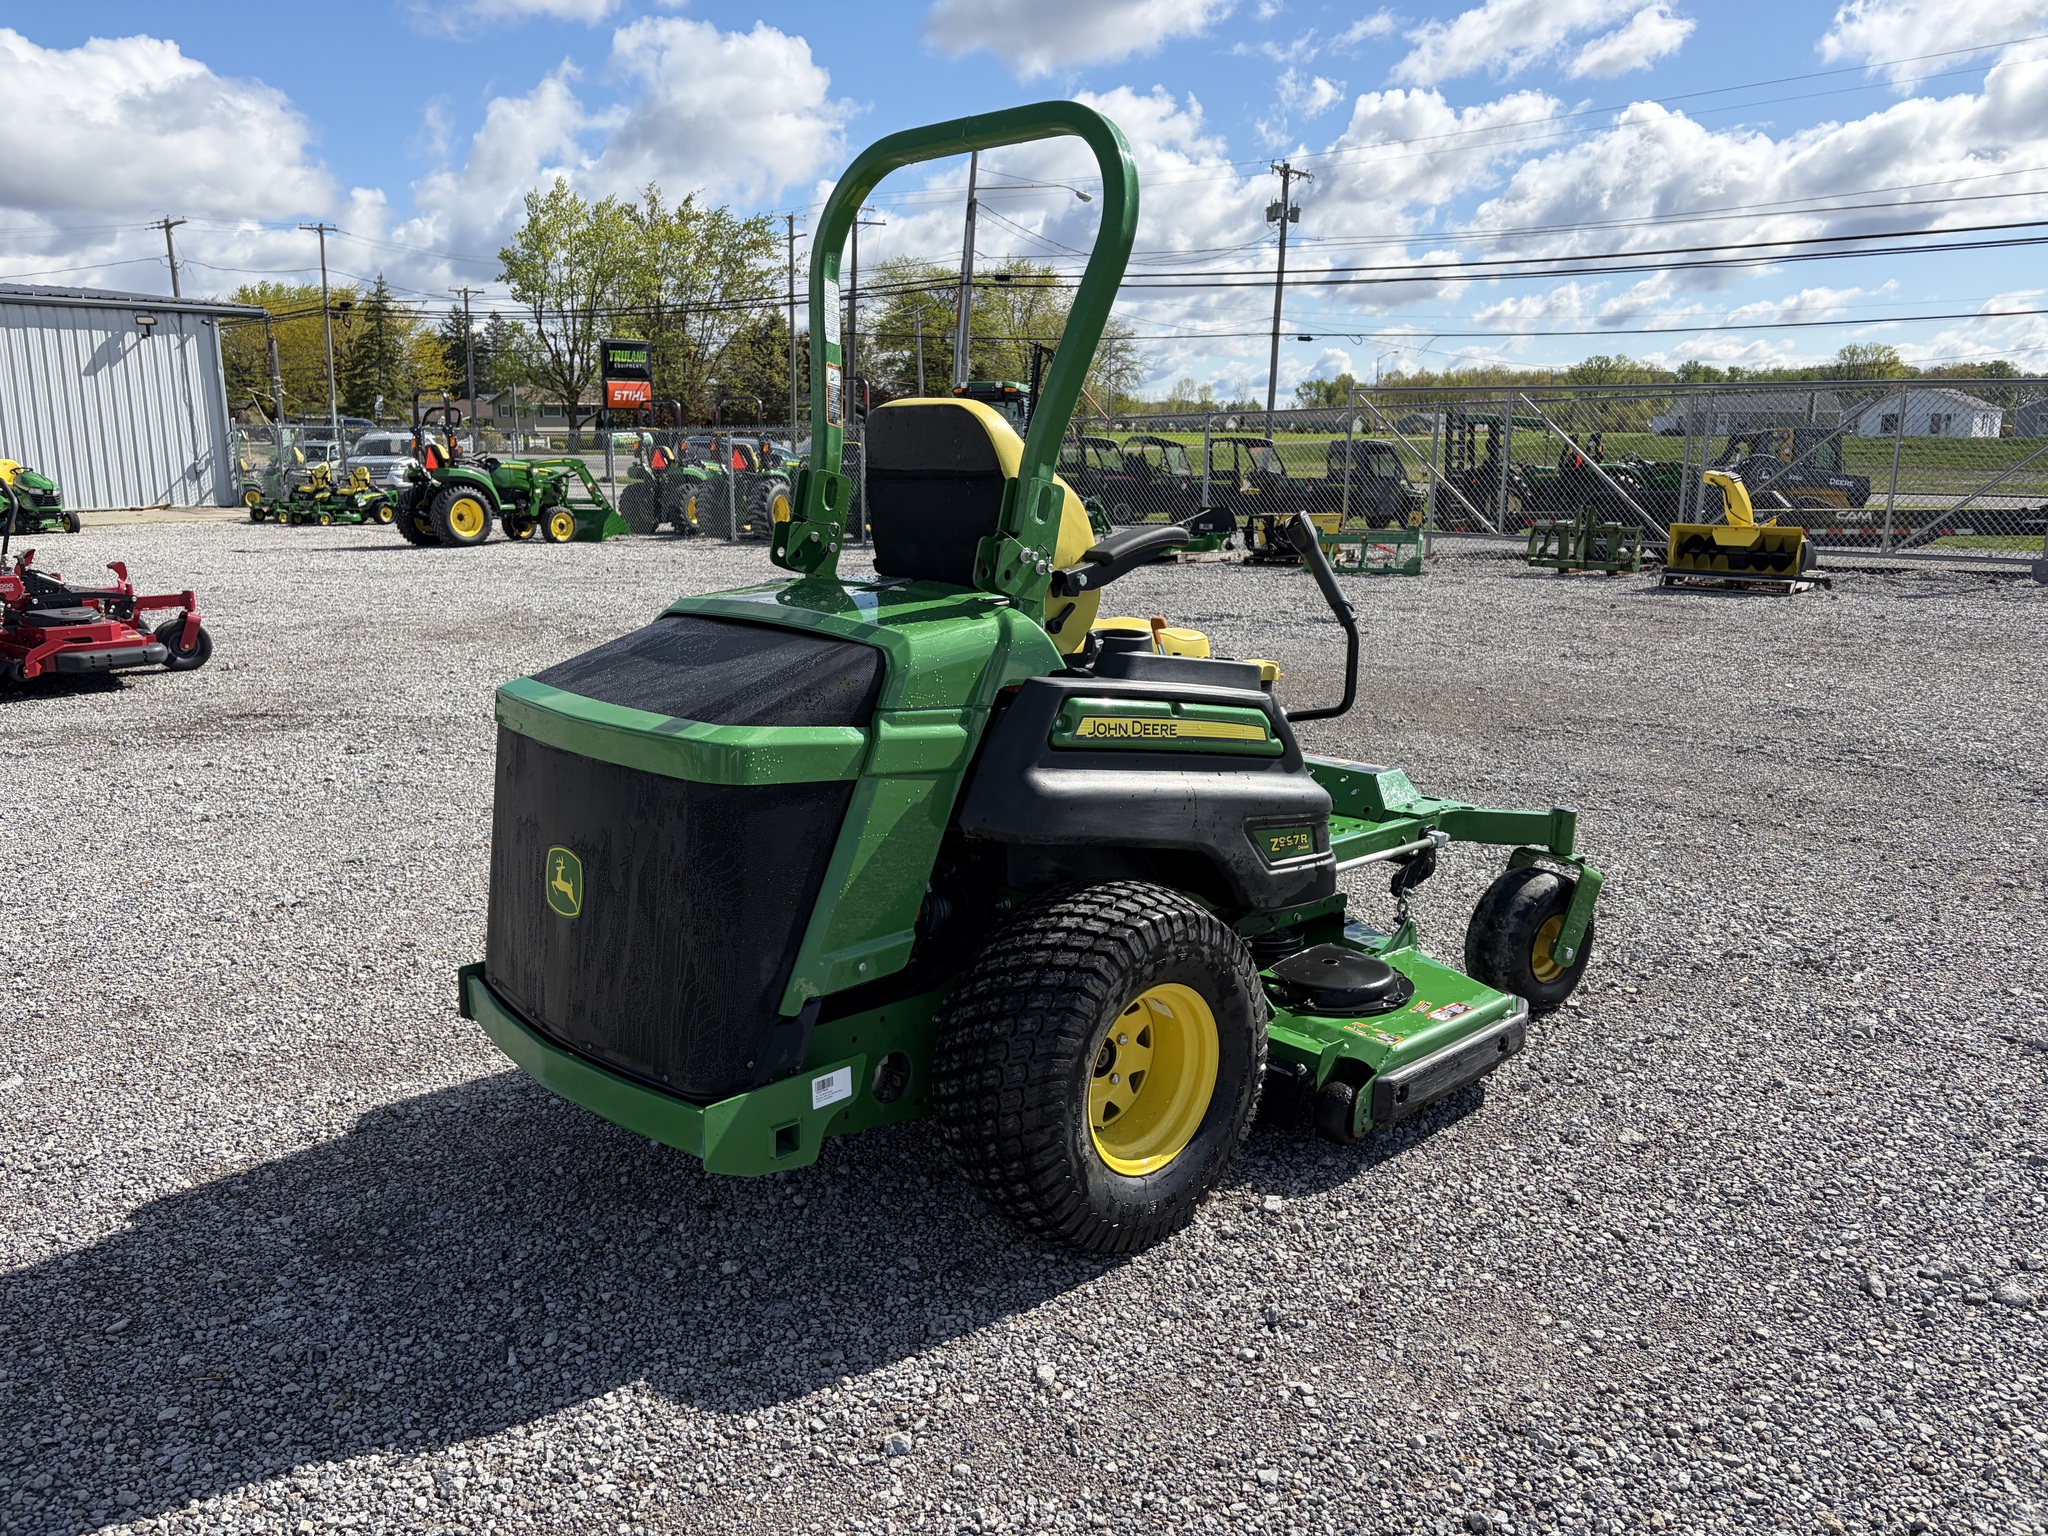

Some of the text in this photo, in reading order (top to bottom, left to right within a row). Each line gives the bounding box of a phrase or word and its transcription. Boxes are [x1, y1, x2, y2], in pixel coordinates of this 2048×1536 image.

[609, 350, 647, 362] TRULAND
[613, 391, 647, 401] STIHL
[1829, 478, 1854, 487] DEERE
[1836, 511, 1873, 520] CAM
[1088, 720, 1178, 736] JOHN DEERE
